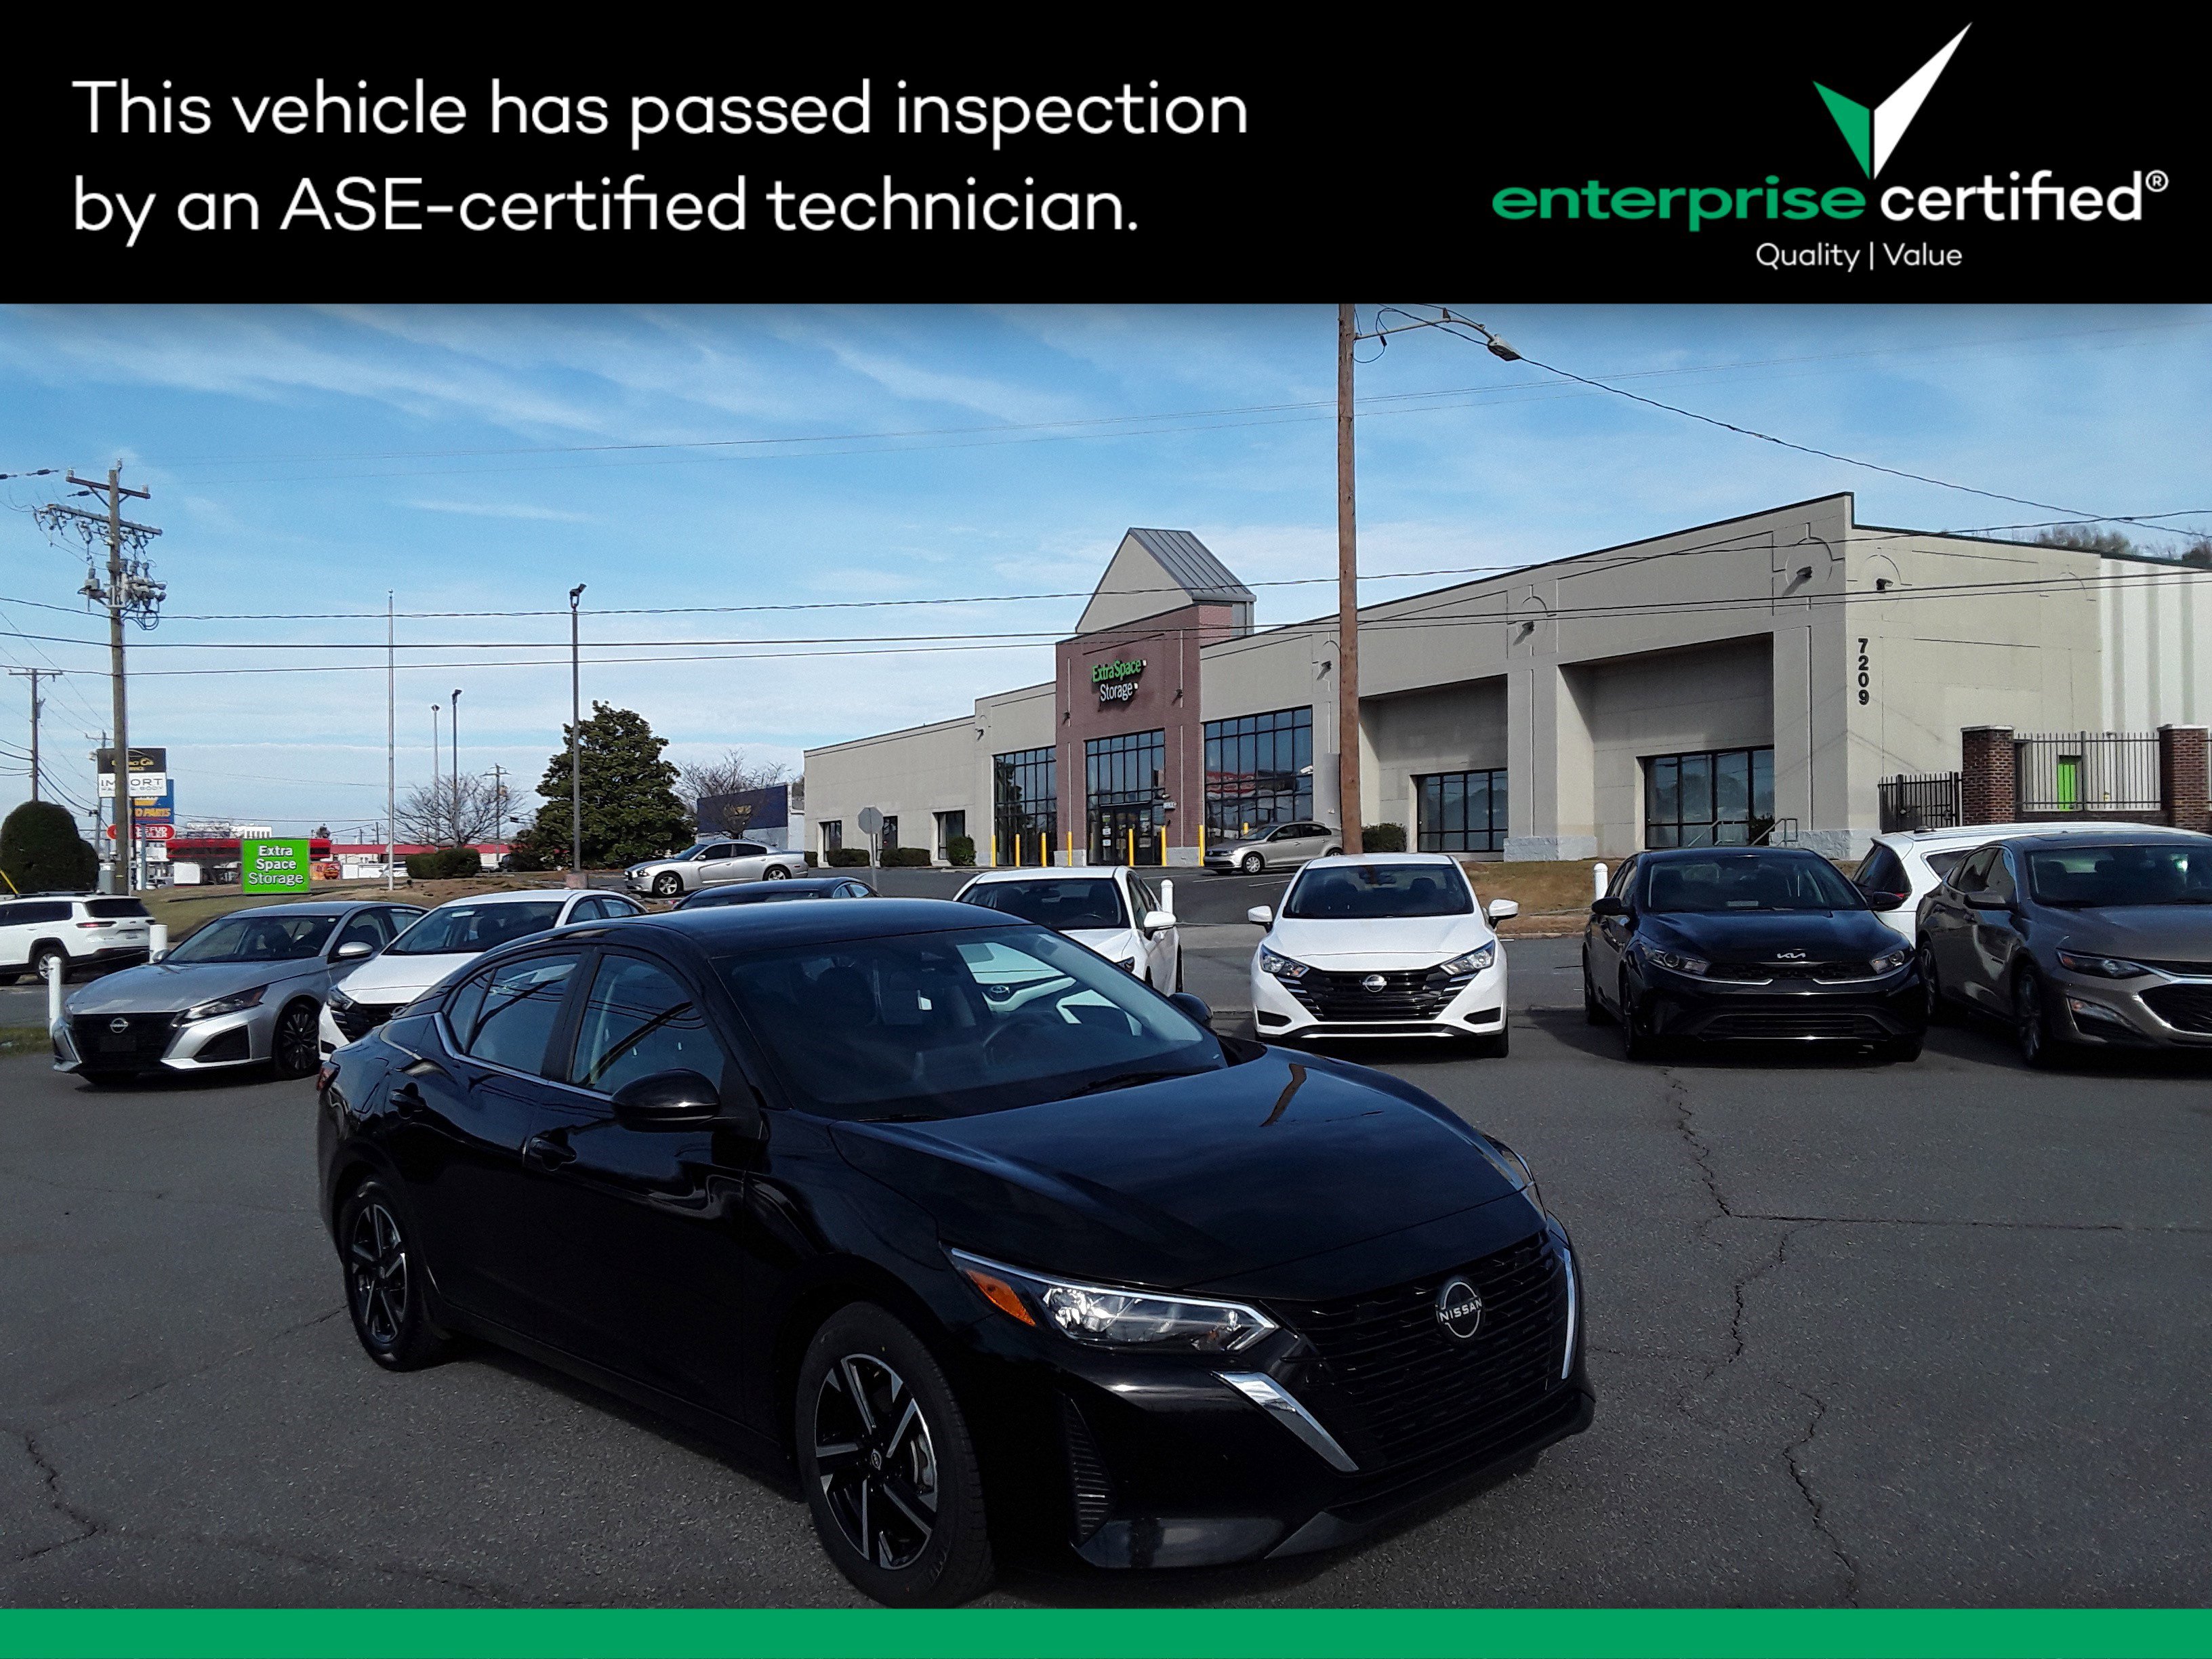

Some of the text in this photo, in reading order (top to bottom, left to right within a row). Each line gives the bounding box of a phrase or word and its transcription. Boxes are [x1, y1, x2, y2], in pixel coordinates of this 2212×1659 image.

[1858, 638, 1869, 705] 7209
[1100, 682, 1133, 701] Storage
[100, 778, 163, 787] IMORT
[259, 845, 293, 857] Extra
[256, 858, 297, 873] Space
[248, 872, 304, 886] Storage
[1439, 1298, 1482, 1322] NISSAN
